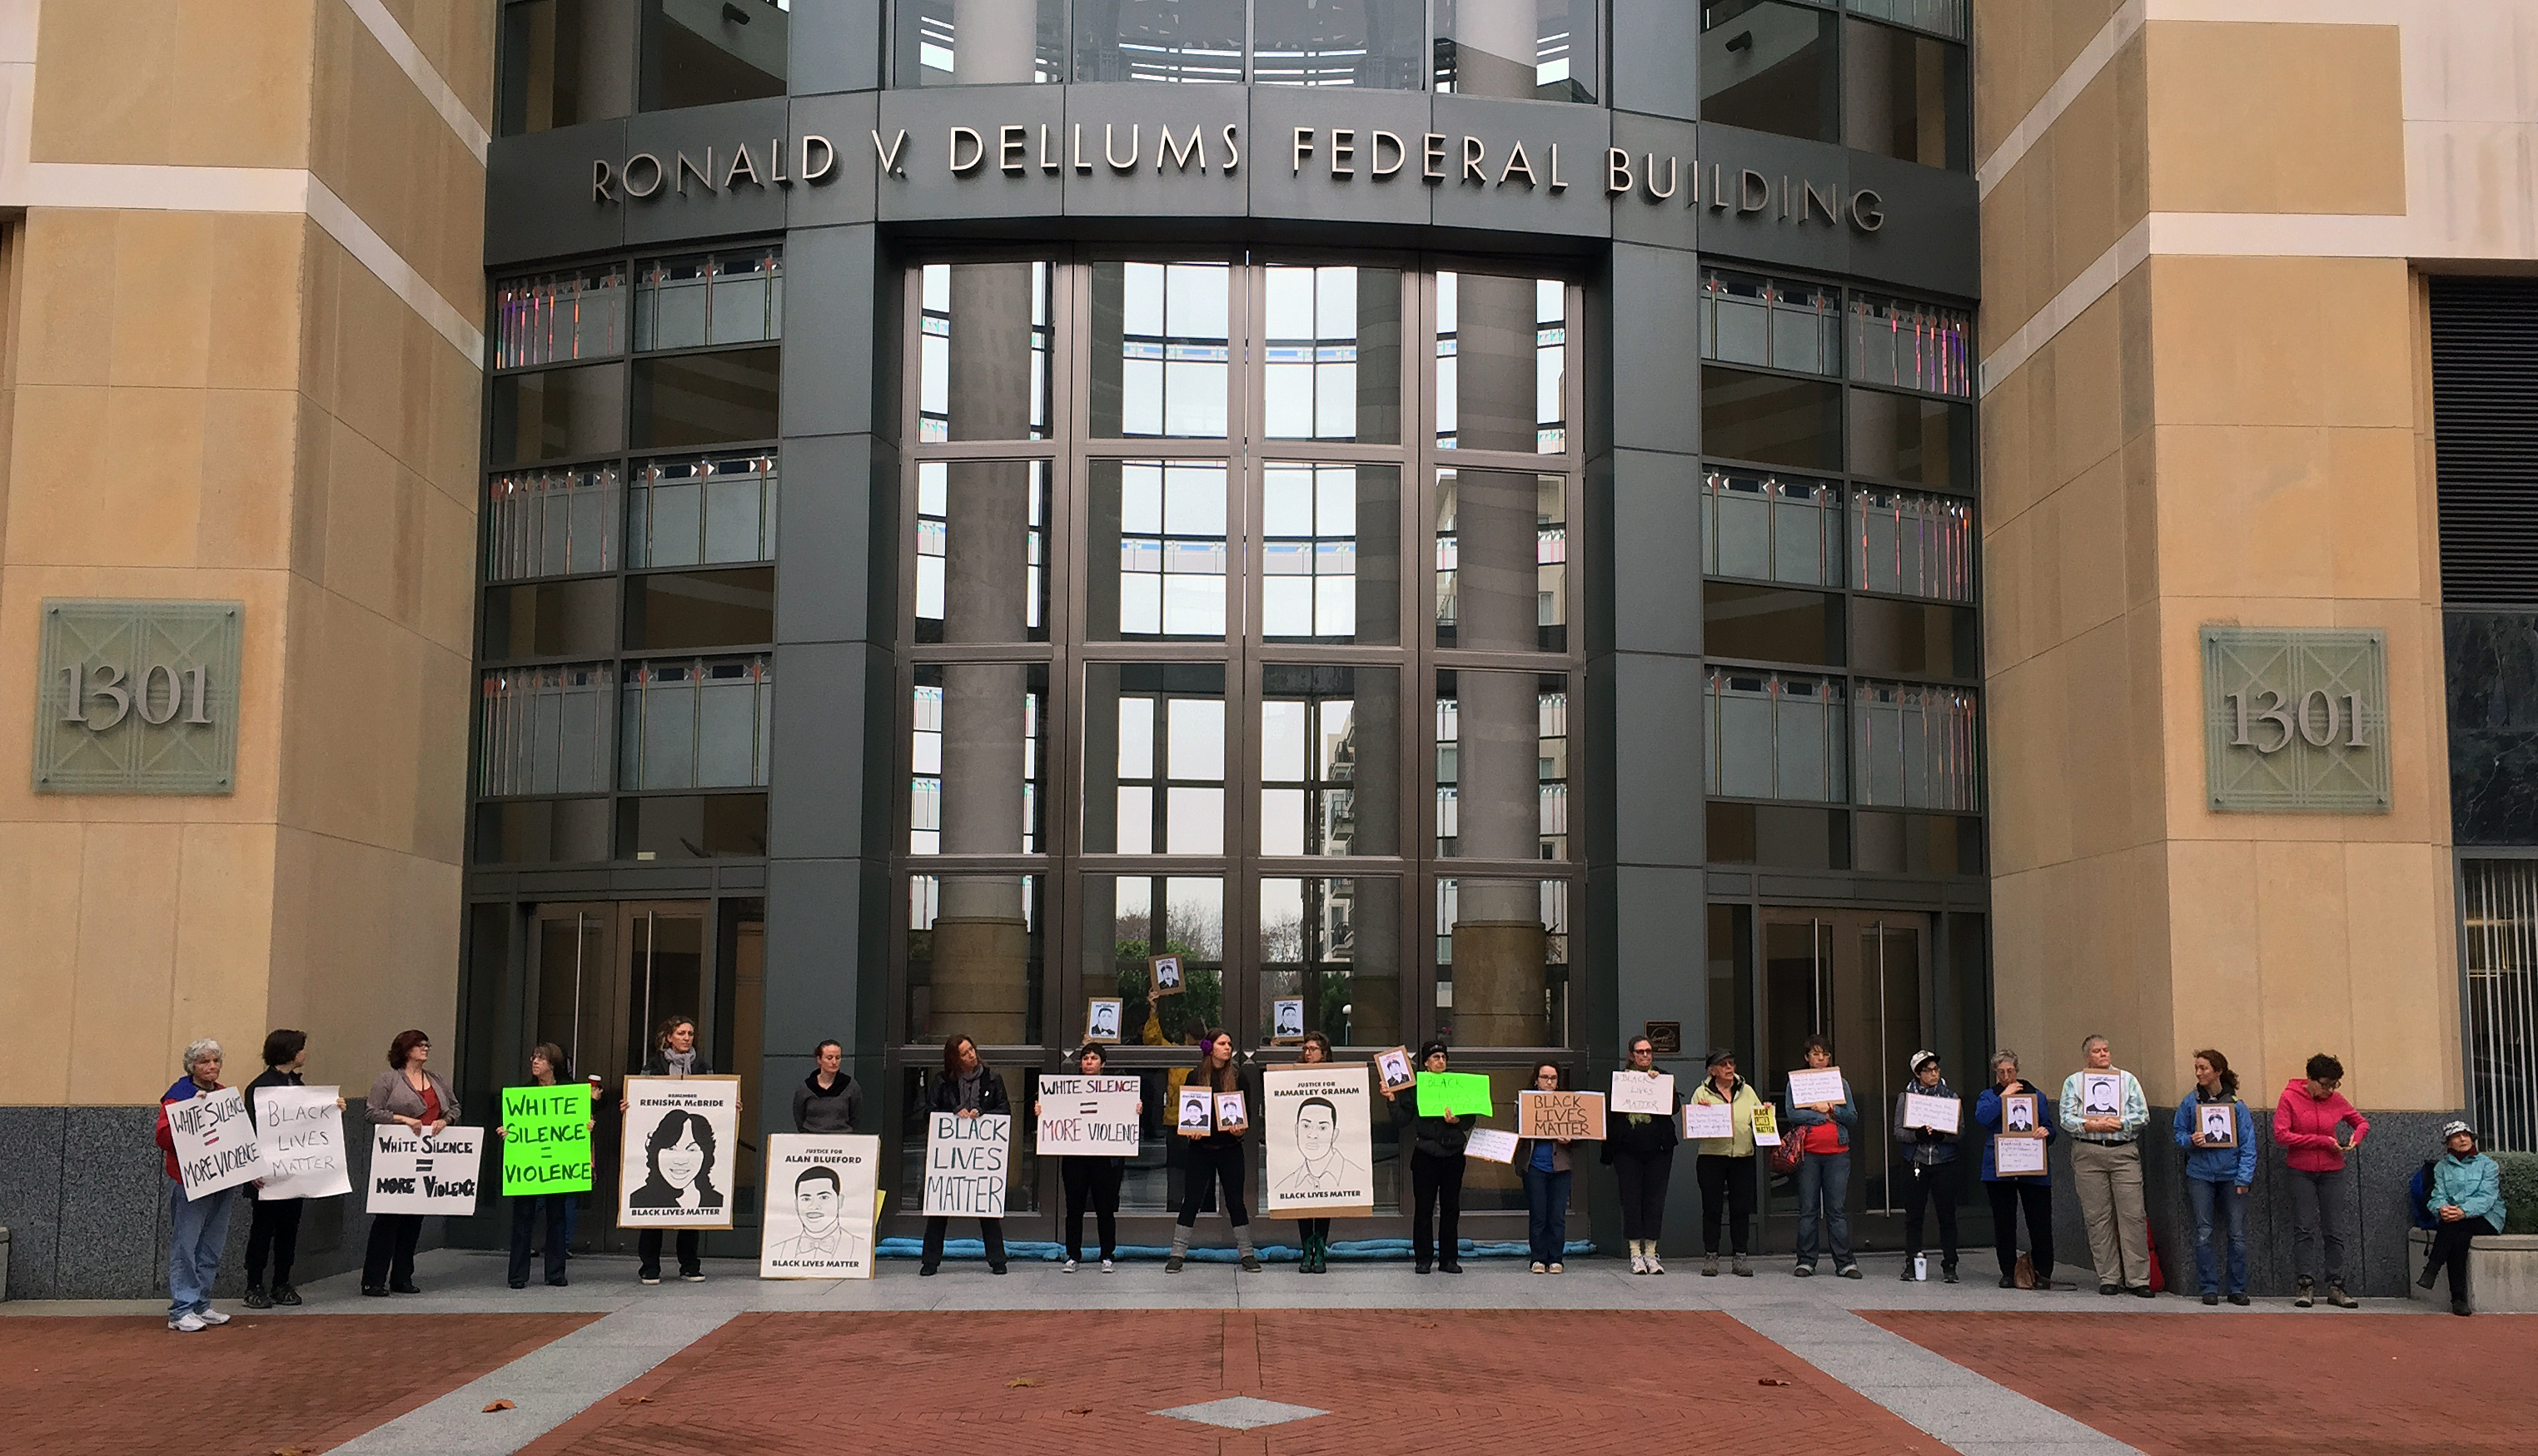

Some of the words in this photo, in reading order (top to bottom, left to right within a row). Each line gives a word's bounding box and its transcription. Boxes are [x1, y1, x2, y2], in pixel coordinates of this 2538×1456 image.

[592, 134, 833, 201] RONALD
[871, 128, 909, 174] V.
[949, 123, 1238, 171] DELLUMS
[1293, 127, 1569, 187] FEDERAL
[1608, 147, 1884, 231] BUILDING
[59, 663, 214, 732] 1301
[2225, 689, 2371, 753] 1301
[1040, 1080, 1082, 1095] WHITE
[1085, 1080, 1139, 1093] SILENCE
[1274, 1089, 1319, 1097] RAMARLEY
[1321, 1087, 1360, 1096] GRAHAM
[1630, 1086, 1654, 1096] LIVES
[505, 1095, 579, 1116] WHITE
[1534, 1095, 1581, 1109] BLACK
[1621, 1099, 1659, 1111] MATTER
[172, 1106, 206, 1135] WHITE
[205, 1096, 245, 1127] SILENCE
[267, 1100, 332, 1126] BLACK
[1535, 1108, 1587, 1123] LIVES
[506, 1123, 586, 1143] SILENCE
[938, 1117, 1008, 1142] BLACK
[1042, 1118, 1082, 1141] MORE
[1087, 1123, 1139, 1145] VIOLENCE
[1534, 1122, 1591, 1135] MATTER
[277, 1131, 329, 1151] LIVES
[183, 1157, 217, 1189] MORE
[214, 1141, 260, 1177] VIOLENCE
[272, 1155, 336, 1177] MATTER
[784, 1155, 811, 1163] ALAN
[814, 1155, 862, 1164] BLUEFORD
[933, 1146, 1003, 1170] LIVES
[505, 1163, 591, 1183] VIOLENCE
[376, 1177, 416, 1195] MORE
[925, 1175, 1003, 1214] MATTER
[1280, 1191, 1306, 1200] BLACK
